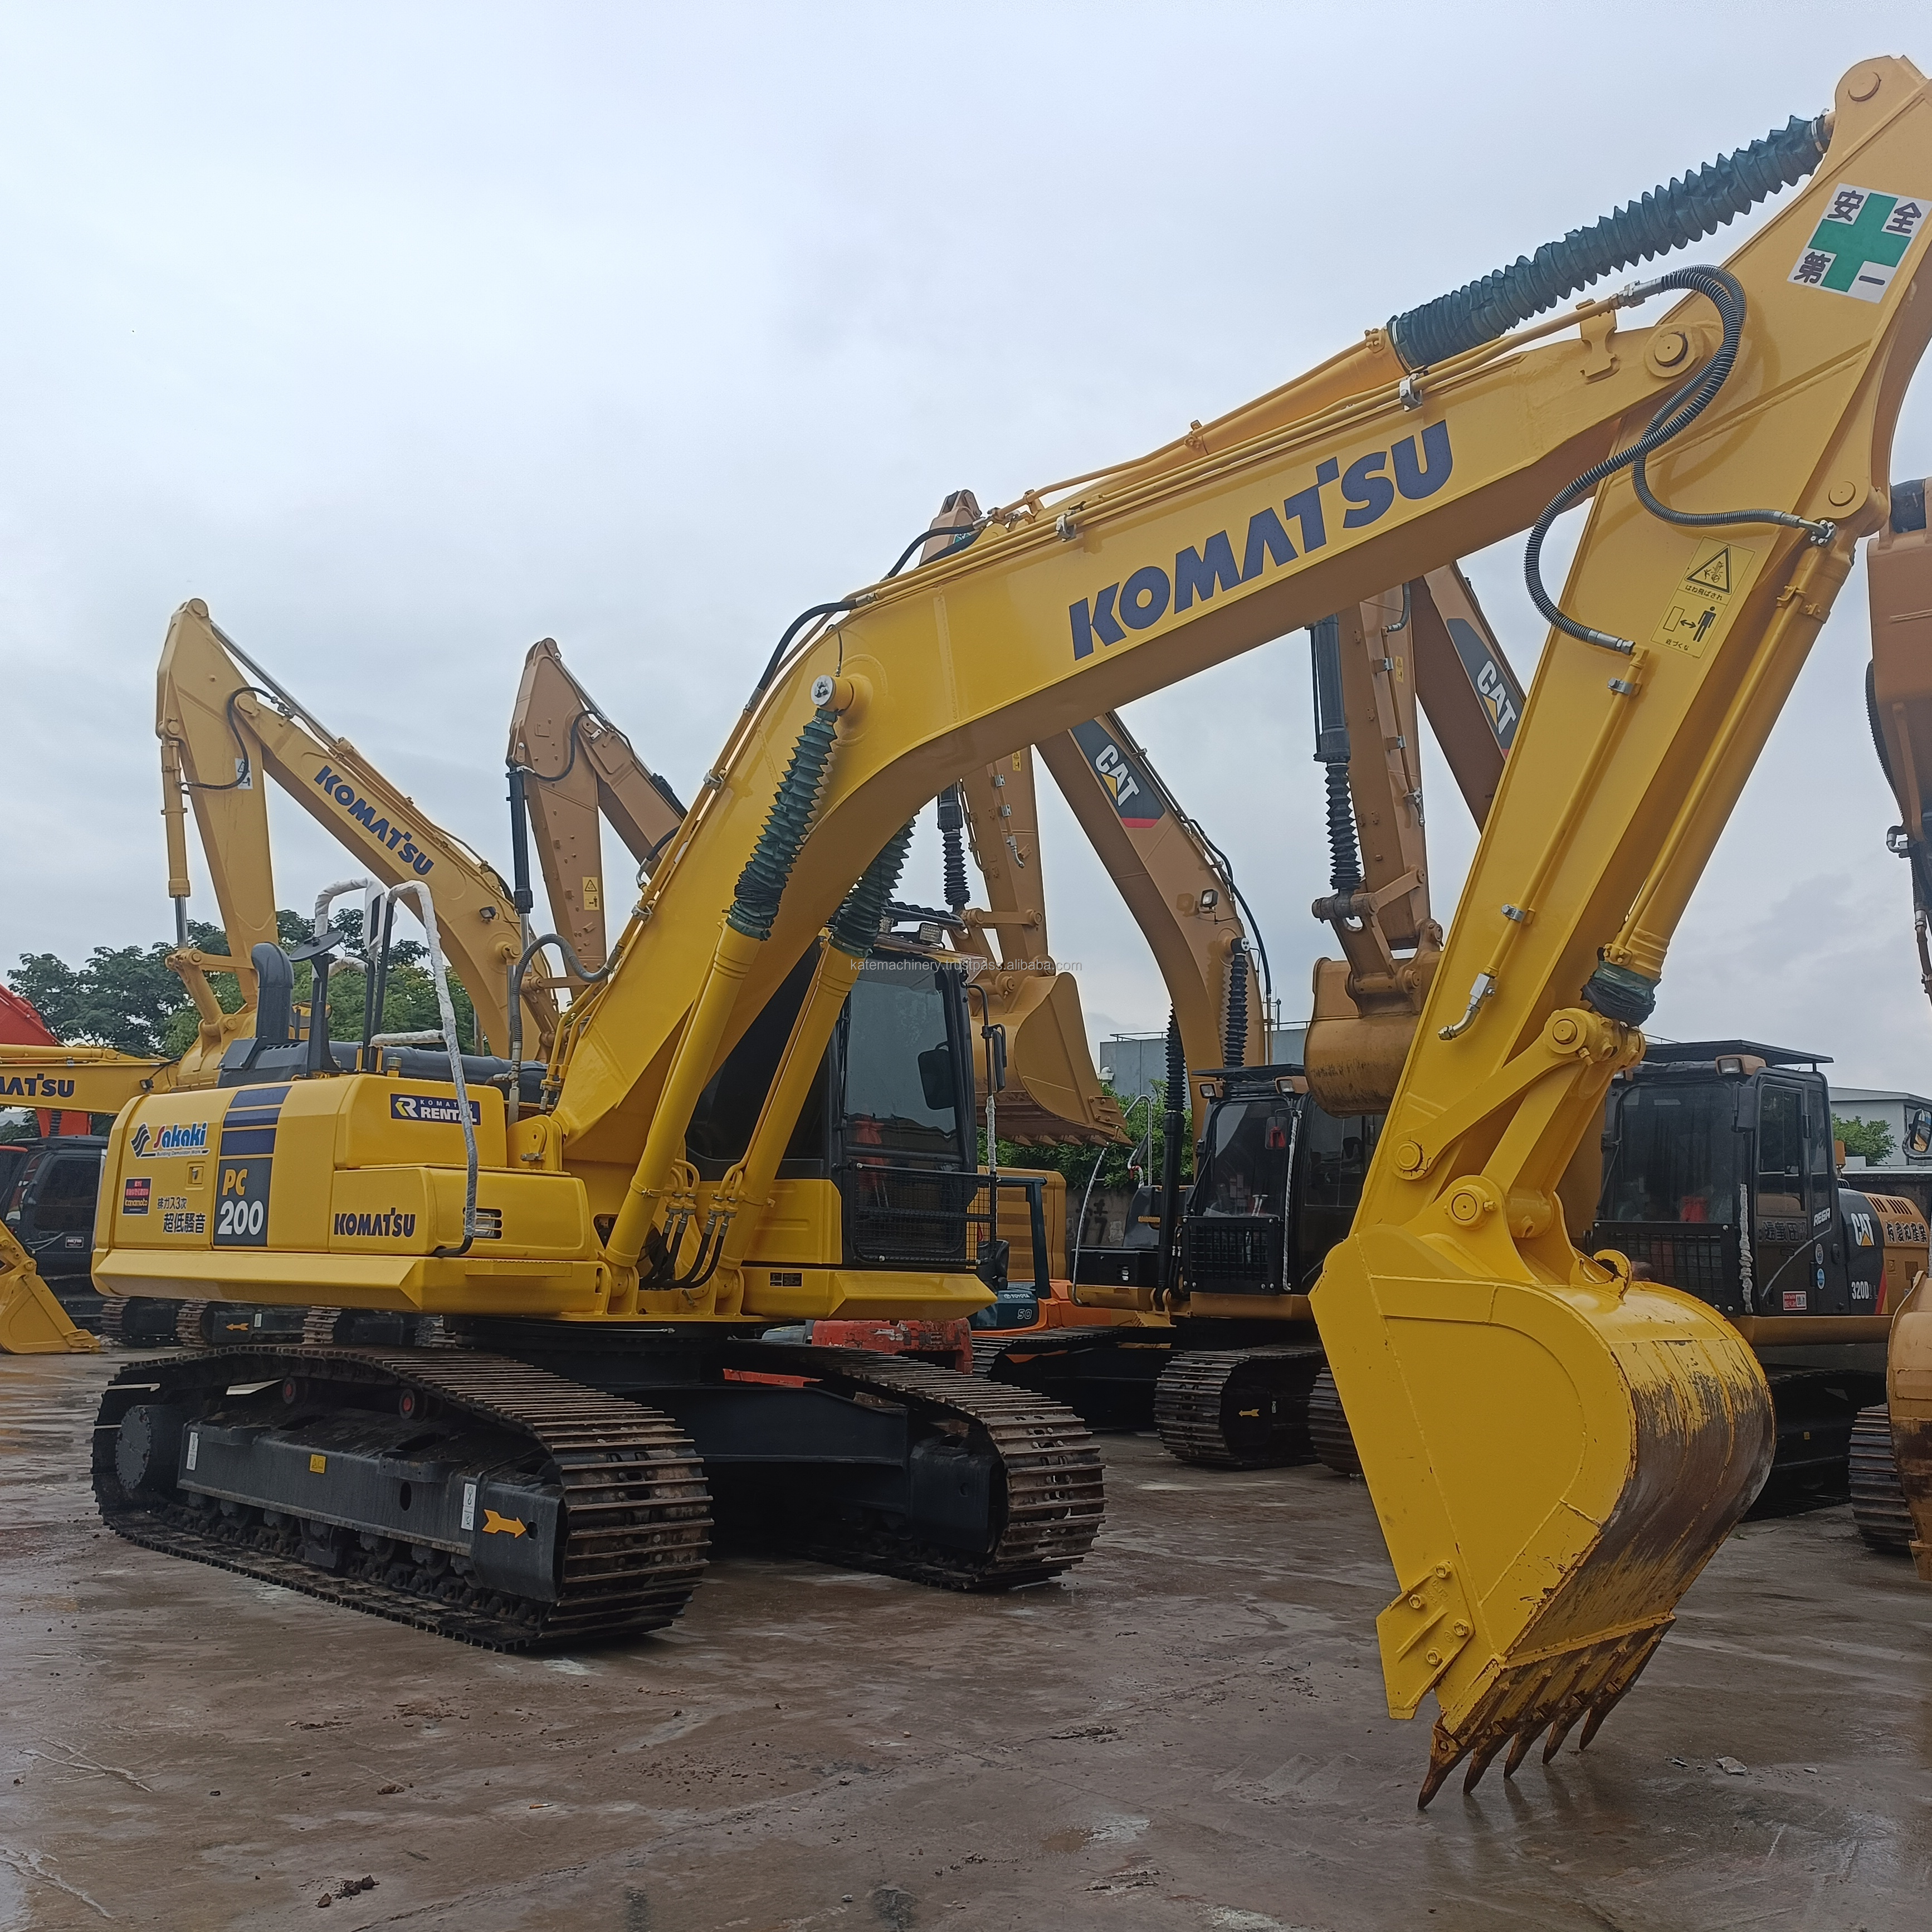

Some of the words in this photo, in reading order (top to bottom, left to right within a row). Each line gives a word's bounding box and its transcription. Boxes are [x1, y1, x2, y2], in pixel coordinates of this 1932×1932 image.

[1069, 419, 1453, 662] KOMATSU
[1685, 584, 1723, 601] はね飛ばされ
[1665, 638, 1690, 651] 近づくな
[1477, 660, 1518, 734] CAT
[1095, 744, 1140, 807] CAT
[314, 765, 435, 876] KOMATSU
[0, 1073, 75, 1098] ATSU
[420, 1099, 472, 1109] KOMATU
[153, 1122, 207, 1148] Sakaki
[222, 1168, 248, 1197] PC
[218, 1199, 264, 1236] 200
[334, 1207, 416, 1238] KOMATSU
[1851, 1213, 1875, 1246] CAT
[1017, 1309, 1032, 1320] 50
